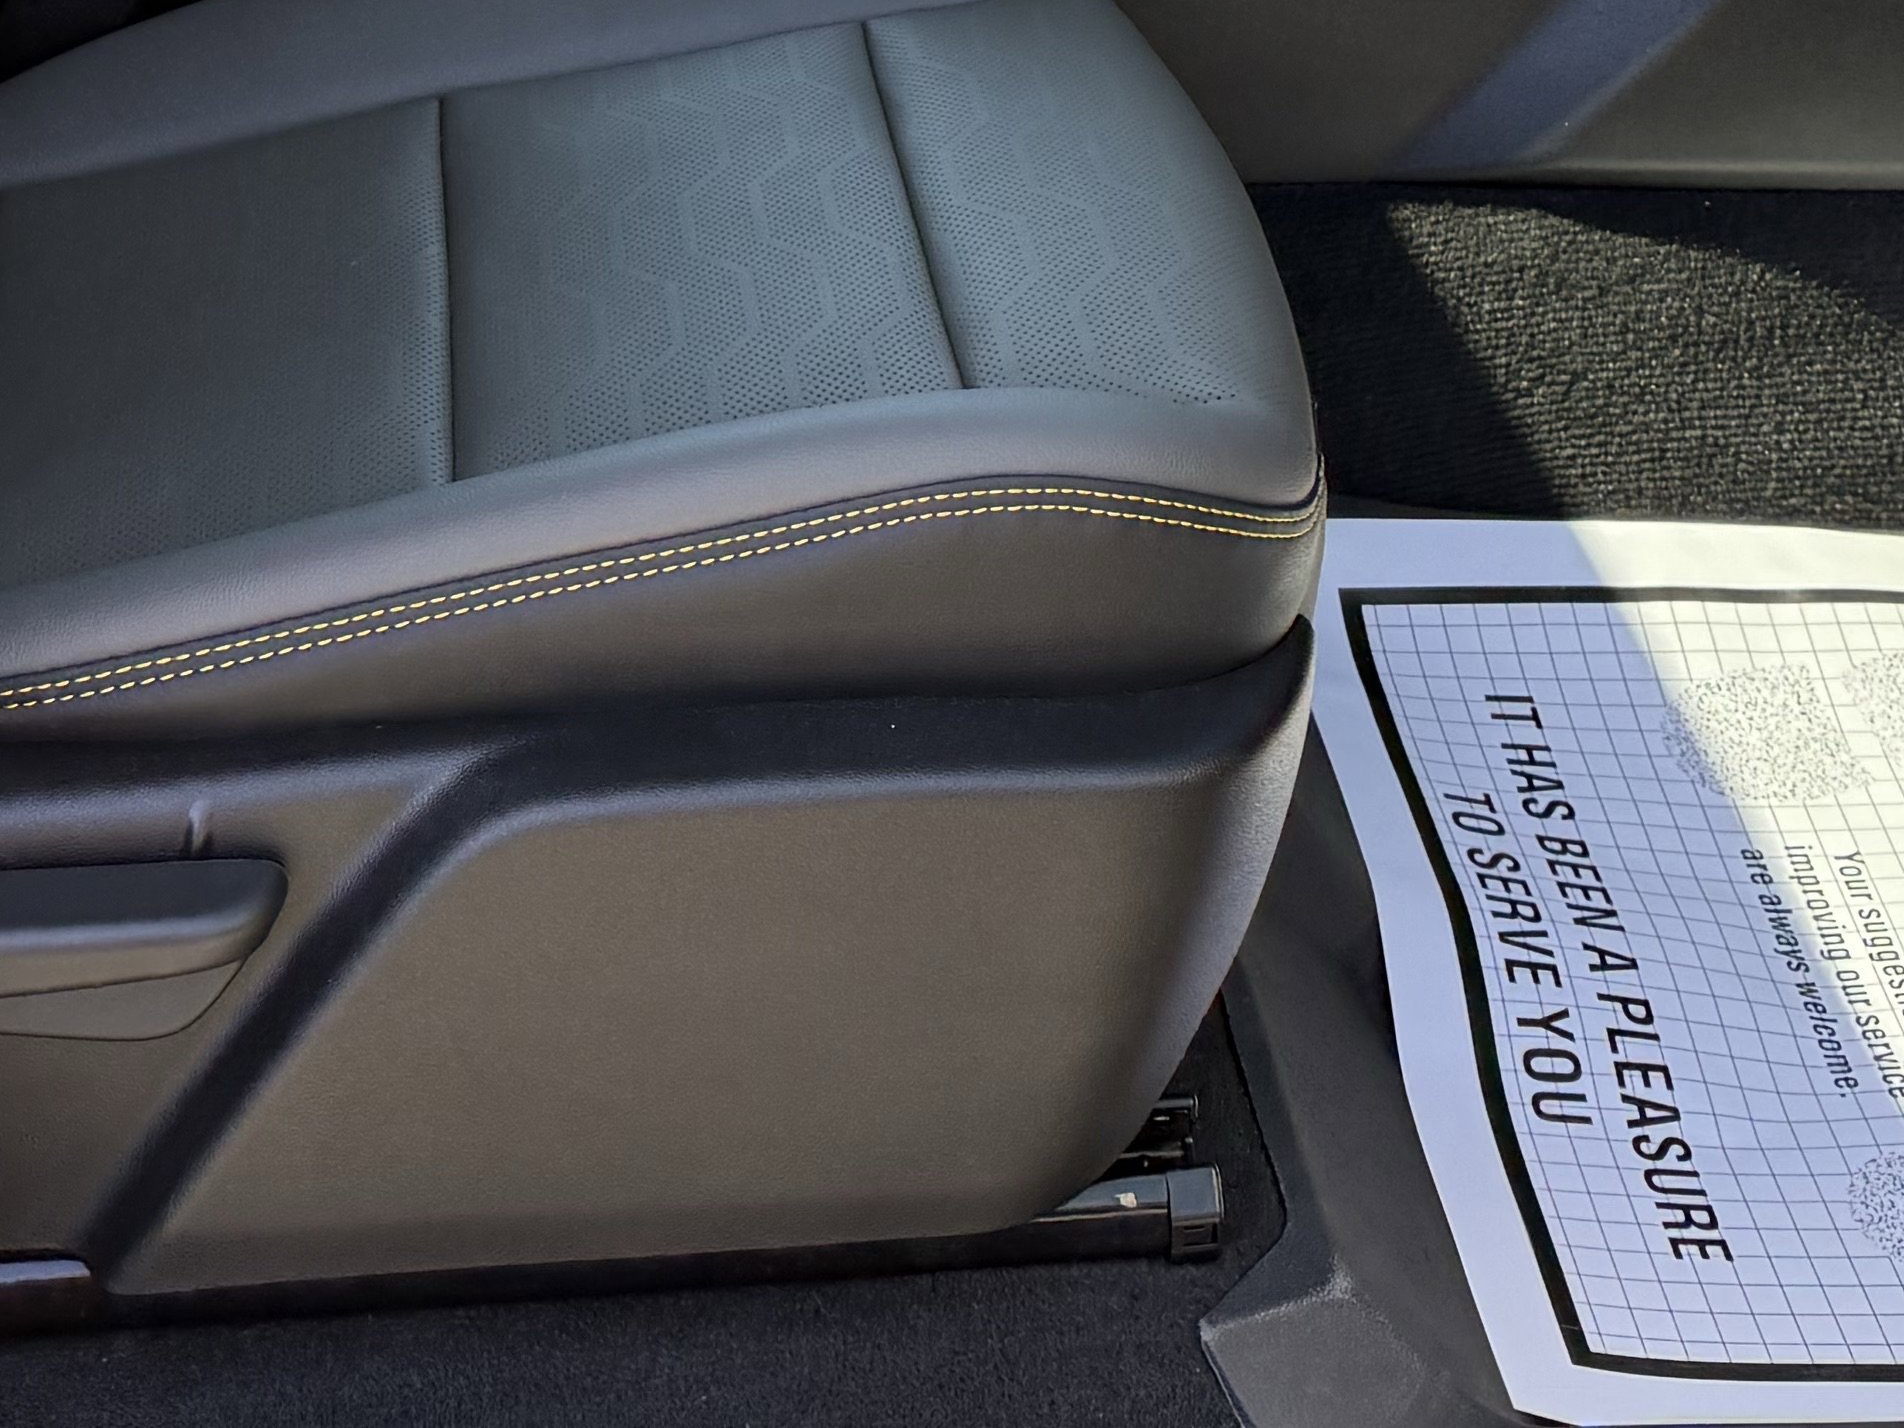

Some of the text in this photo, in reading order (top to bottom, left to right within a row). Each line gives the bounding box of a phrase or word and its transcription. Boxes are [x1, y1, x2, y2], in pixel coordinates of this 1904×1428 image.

[1443, 793, 1593, 1127] TO SERVE YOU
[1485, 695, 1734, 1262] IT HAS BEEN A PLEASURE
[1740, 848, 1859, 1098] are always welcome.
[1784, 845, 1852, 961] improving
[1836, 970, 1872, 1007] our
[1834, 850, 1873, 901] Your
